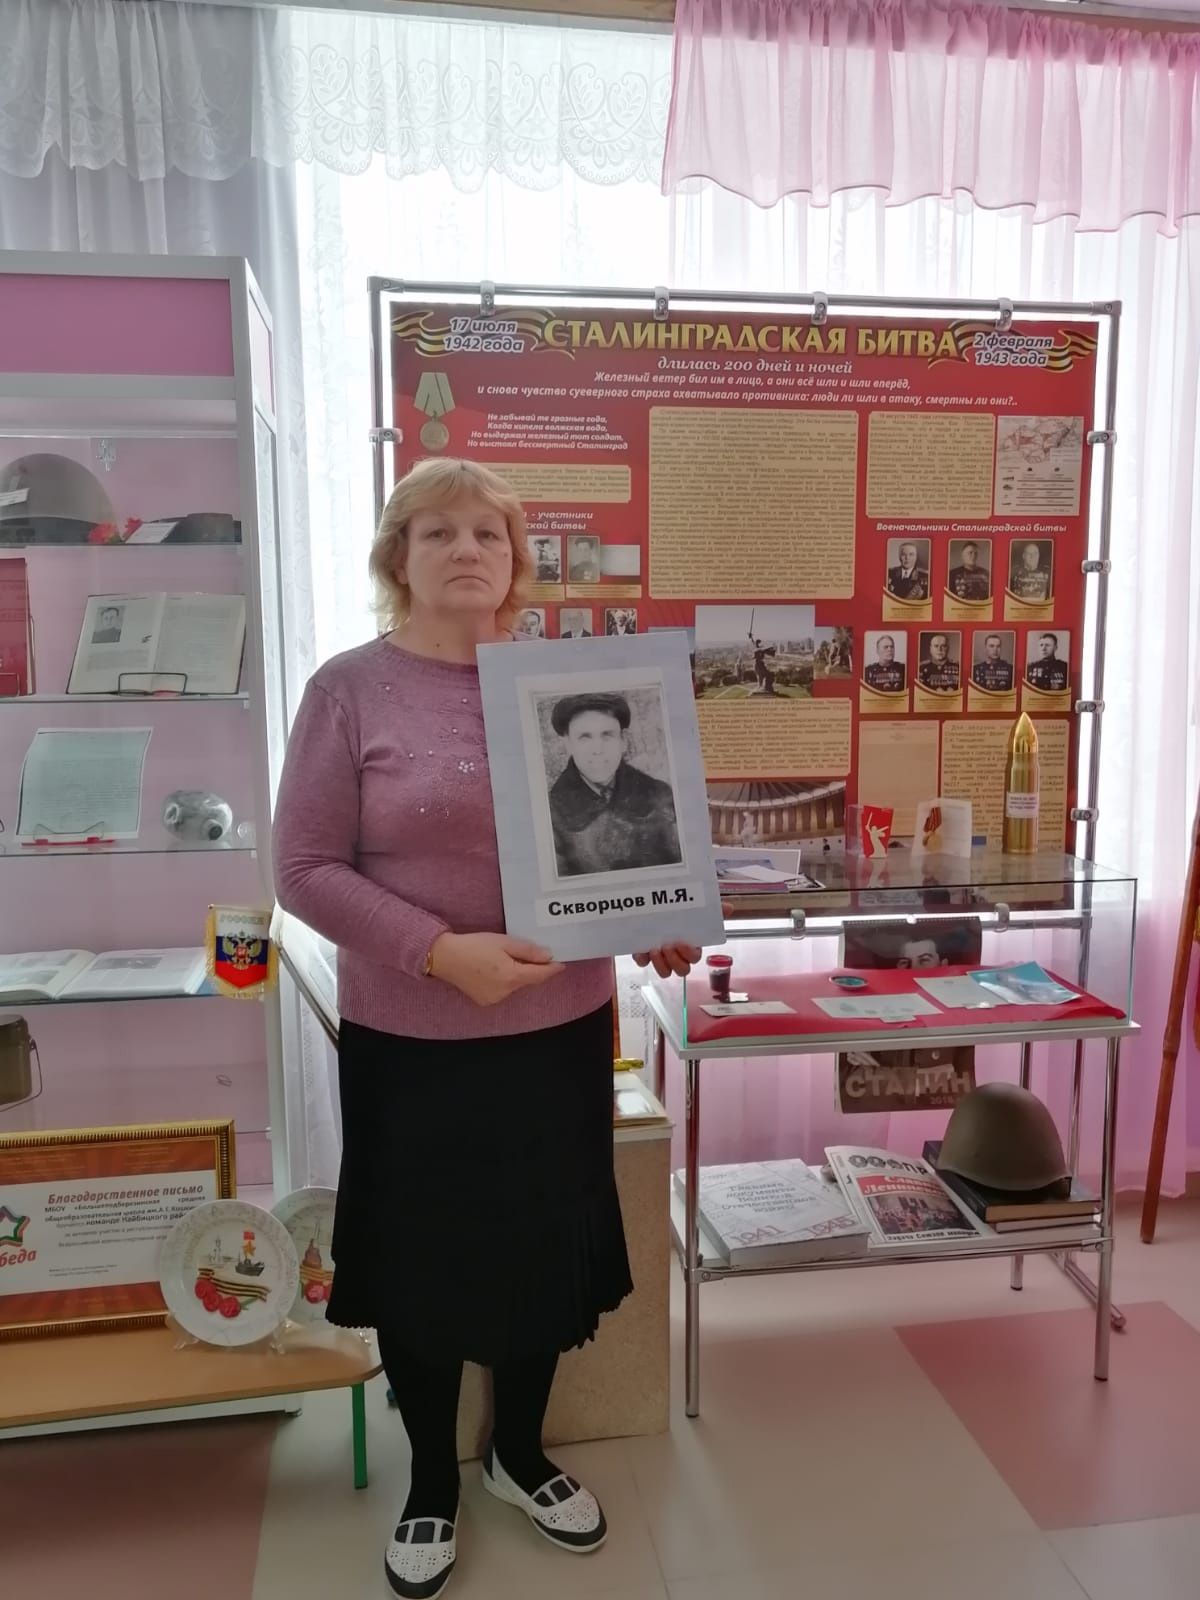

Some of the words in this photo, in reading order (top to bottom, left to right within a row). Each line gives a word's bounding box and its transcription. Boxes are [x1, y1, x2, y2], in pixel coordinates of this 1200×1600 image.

[449, 317, 470, 333] 17
[472, 319, 518, 334] июля
[444, 336, 480, 351] 1942
[483, 338, 524, 353] года
[544, 319, 847, 355] СТАЛИНГРАДСКАЯ
[856, 328, 959, 357] БИТВА
[974, 334, 985, 348] 2
[986, 333, 1053, 351] февраля
[658, 356, 720, 372] длилась
[723, 361, 752, 372] 200
[757, 359, 792, 373] дней
[795, 364, 805, 373] и
[808, 360, 854, 375] ночей
[976, 352, 1009, 366] 1943
[1011, 352, 1048, 366] года
[594, 371, 651, 383] Железный
[653, 374, 686, 386] ветер
[688, 373, 708, 385] бил
[710, 376, 726, 385] им
[736, 376, 765, 388] лицо,
[776, 377, 795, 387] они
[797, 375, 815, 388] всё
[816, 379, 838, 388] шли
[849, 380, 871, 390] шли
[873, 380, 911, 391] вперёд,
[478, 386, 486, 395] и
[487, 387, 518, 396] снова
[521, 387, 567, 398] чувство
[569, 388, 629, 400] суеверного
[631, 390, 671, 401] страха
[673, 389, 740, 401] охватывало
[742, 392, 809, 404] противника:
[811, 394, 839, 404] люди
[841, 395, 853, 404] ли
[856, 396, 878, 404] шли
[888, 396, 923, 407] атаку,
[925, 397, 973, 407] смертны
[975, 398, 988, 406] ли
[990, 397, 1018, 406] они?..
[488, 413, 498, 421] Не
[499, 413, 536, 422] забывай
[471, 431, 482, 439] Но
[483, 431, 527, 441] выдержал
[488, 422, 512, 432] Когда
[514, 424, 544, 433] кипела
[546, 423, 585, 432] волжская
[519, 440, 576, 450] бессмертный
[577, 440, 628, 451] Сталинград
[538, 511, 594, 523] участники
[551, 521, 586, 530] битвы
[876, 523, 950, 534] Военачальники
[951, 523, 1032, 537] Сталинградской
[1033, 524, 1067, 535] битвы
[548, 895, 645, 917] Скворцов
[651, 887, 694, 906] М.Я.
[48, 1190, 159, 1206] Благодарственное
[162, 1184, 204, 1198] письмо
